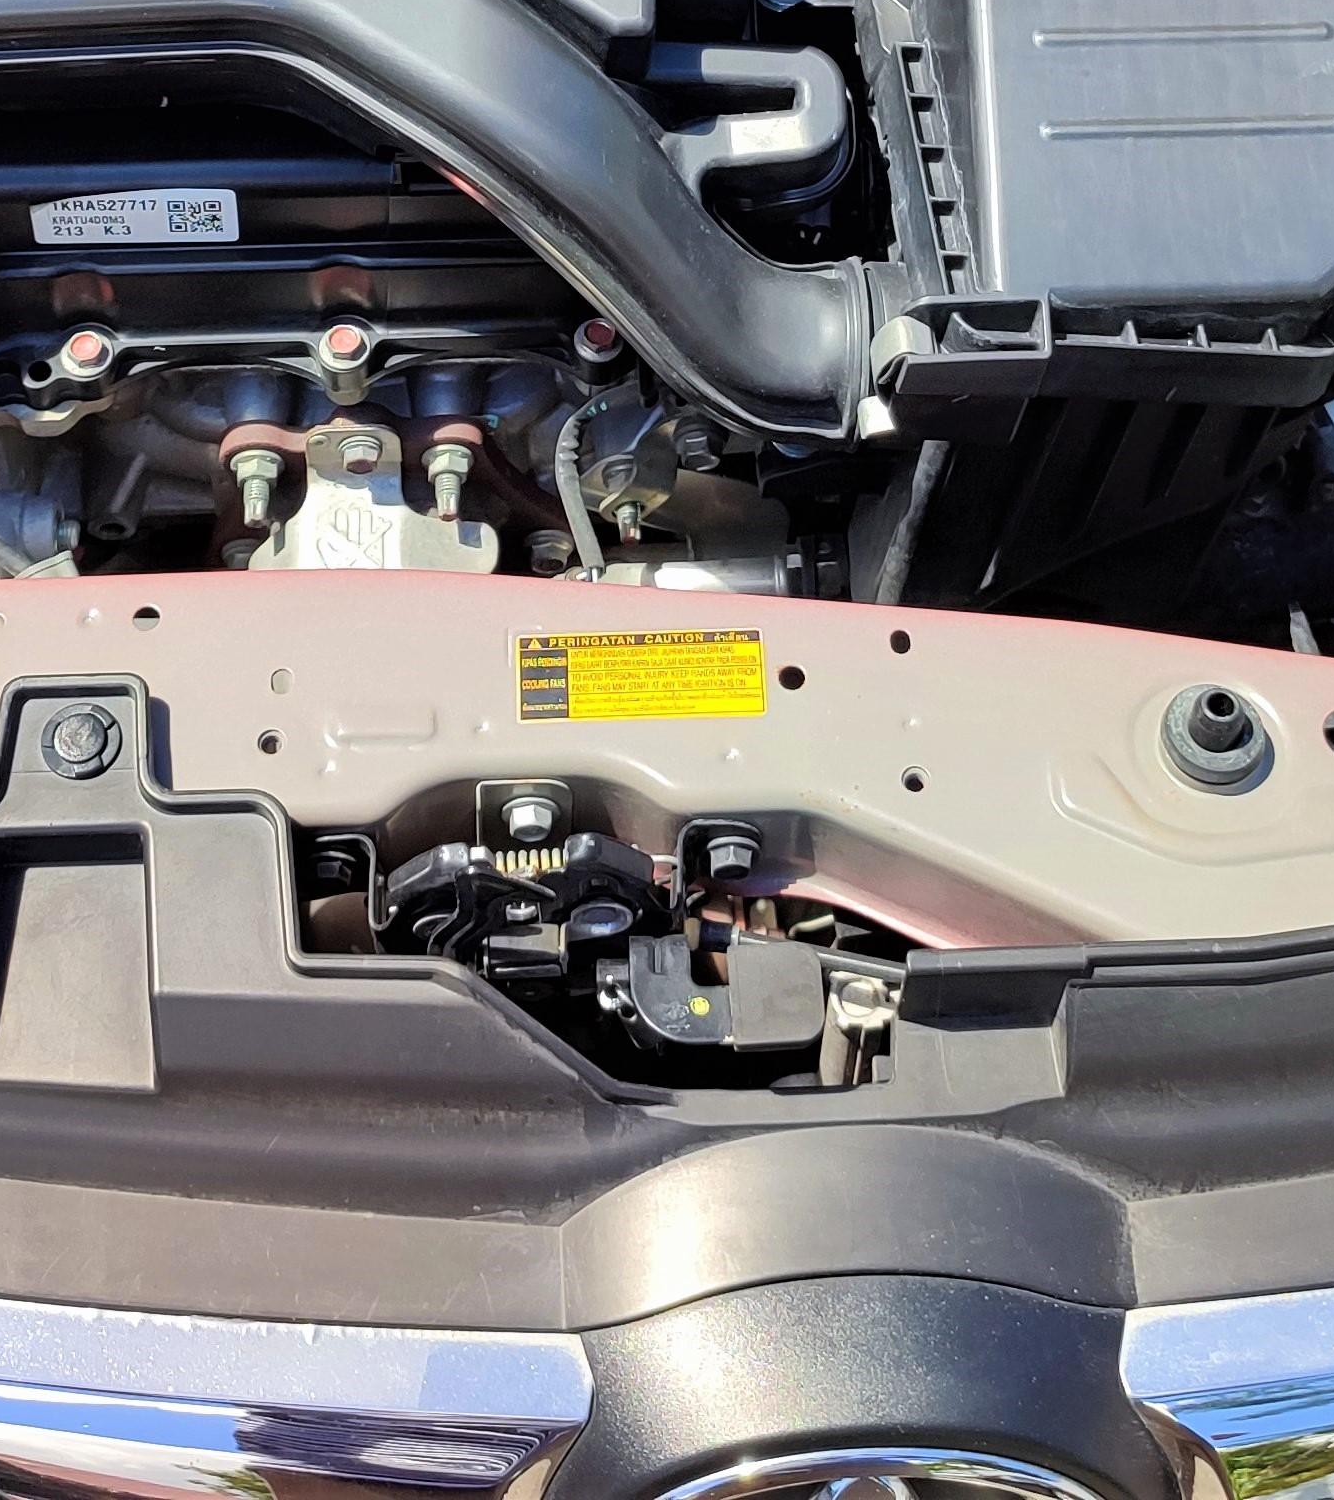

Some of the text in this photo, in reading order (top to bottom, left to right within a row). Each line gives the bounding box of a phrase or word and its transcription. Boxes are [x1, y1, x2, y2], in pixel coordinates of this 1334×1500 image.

[52, 200, 157, 213] 1KRA527717
[53, 226, 84, 237] 213
[548, 633, 704, 647] PERINGATAN CAUTION
